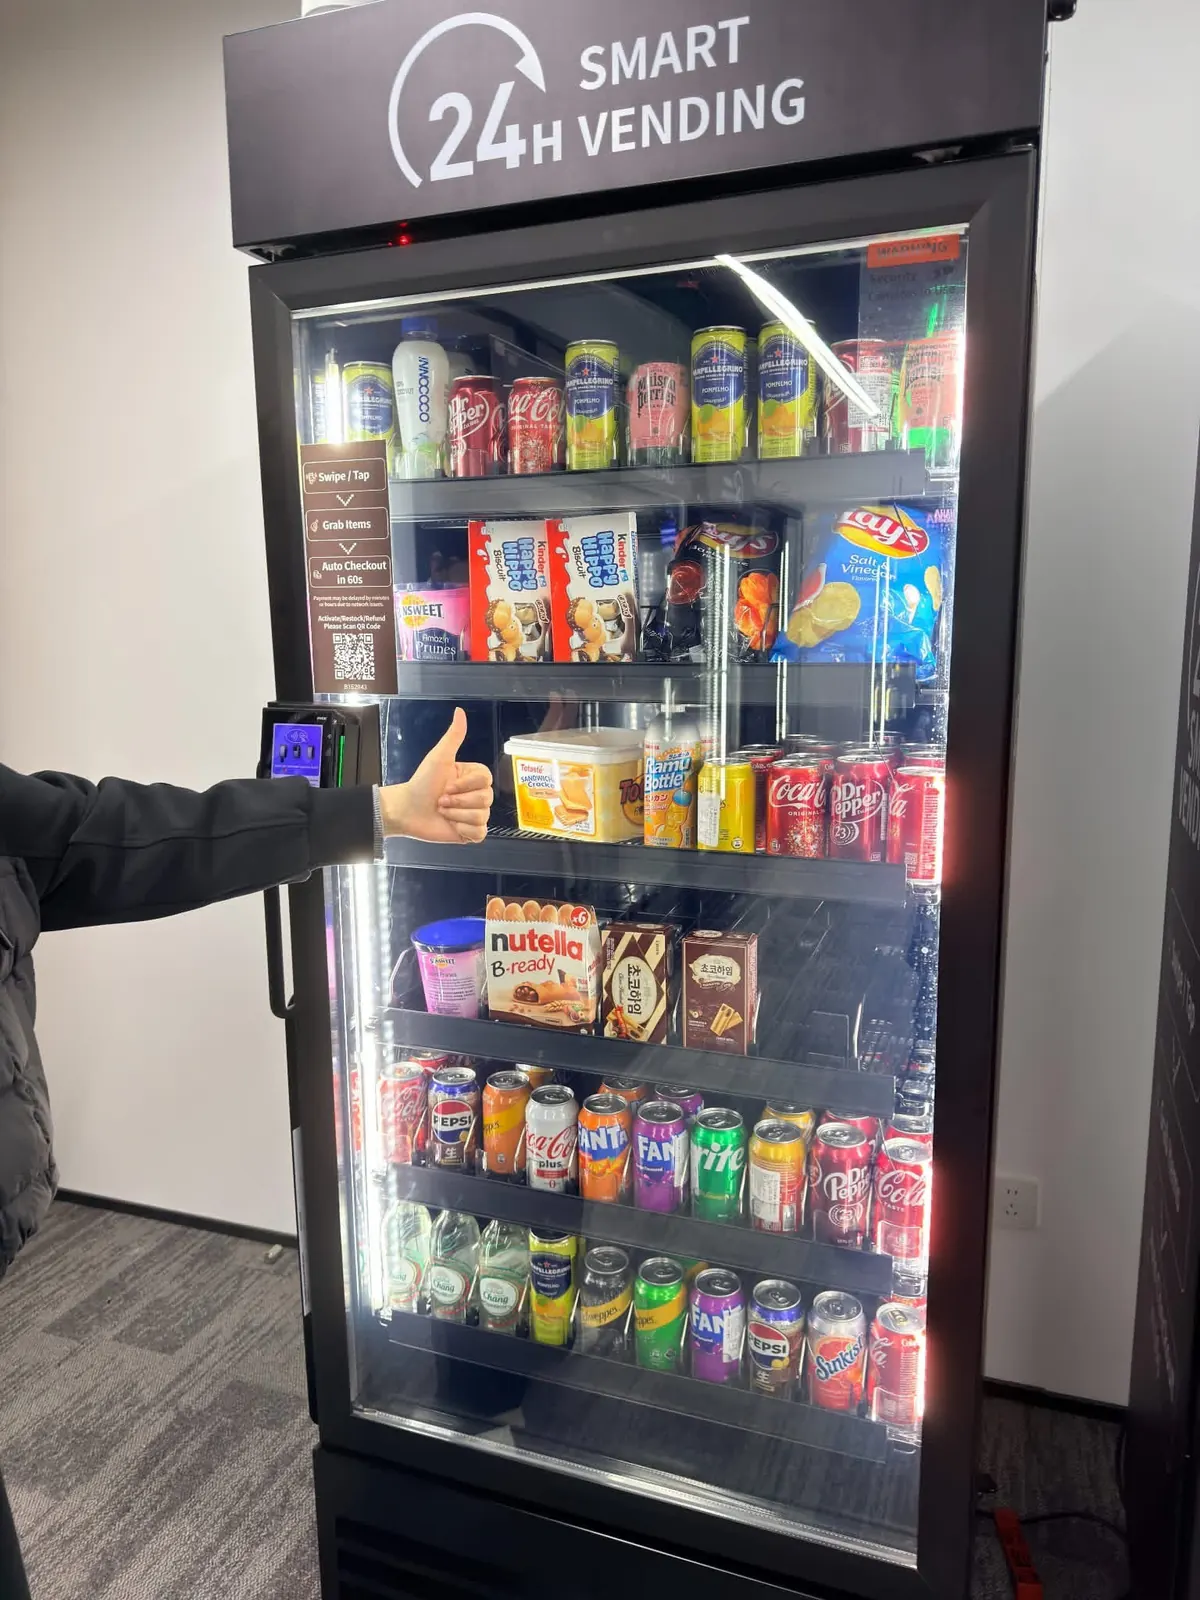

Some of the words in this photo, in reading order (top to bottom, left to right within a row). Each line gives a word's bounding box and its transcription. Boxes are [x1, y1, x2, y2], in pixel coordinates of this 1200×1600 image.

[578, 16, 750, 91] SMART
[578, 77, 806, 157] VENDING
[702, 386, 729, 394] POMPELMO
[766, 380, 792, 388] POMPELMO
[318, 471, 346, 482] Swipe
[353, 470, 370, 482] Tap
[322, 520, 344, 530] Grab
[345, 519, 371, 529] Items
[838, 511, 923, 546] Lay's
[537, 541, 548, 574] Kinder
[597, 531, 620, 586] Happy
[618, 533, 627, 568] Kinder
[849, 554, 877, 566] Salt
[322, 561, 342, 571] Auto
[344, 560, 387, 571] Checkout
[493, 550, 506, 581] Biscuit
[502, 541, 523, 592] Hippo
[518, 537, 538, 590] Happy
[572, 546, 586, 579] Biscuit
[581, 536, 604, 588] Hippo
[841, 564, 896, 580] Vinegar
[337, 575, 346, 584] in
[347, 575, 363, 584] 60s
[402, 603, 443, 618] NSWEET
[324, 622, 341, 630] Please
[343, 622, 356, 630] Scan
[357, 622, 365, 630] QR
[366, 622, 381, 630] Code
[416, 641, 456, 658] Prunes
[646, 757, 690, 774] Ramu
[644, 772, 683, 793] Bottle
[842, 782, 866, 801] Dr
[491, 928, 583, 961] nutella
[491, 954, 556, 978] B-ready
[433, 1115, 472, 1128] PEPSI
[638, 1134, 673, 1162] FAN
[699, 1142, 745, 1172] rite
[539, 1160, 562, 1169] plus
[483, 1291, 509, 1304] Chang
[692, 1304, 725, 1334] FAN
[816, 1332, 864, 1381] Sunkist
